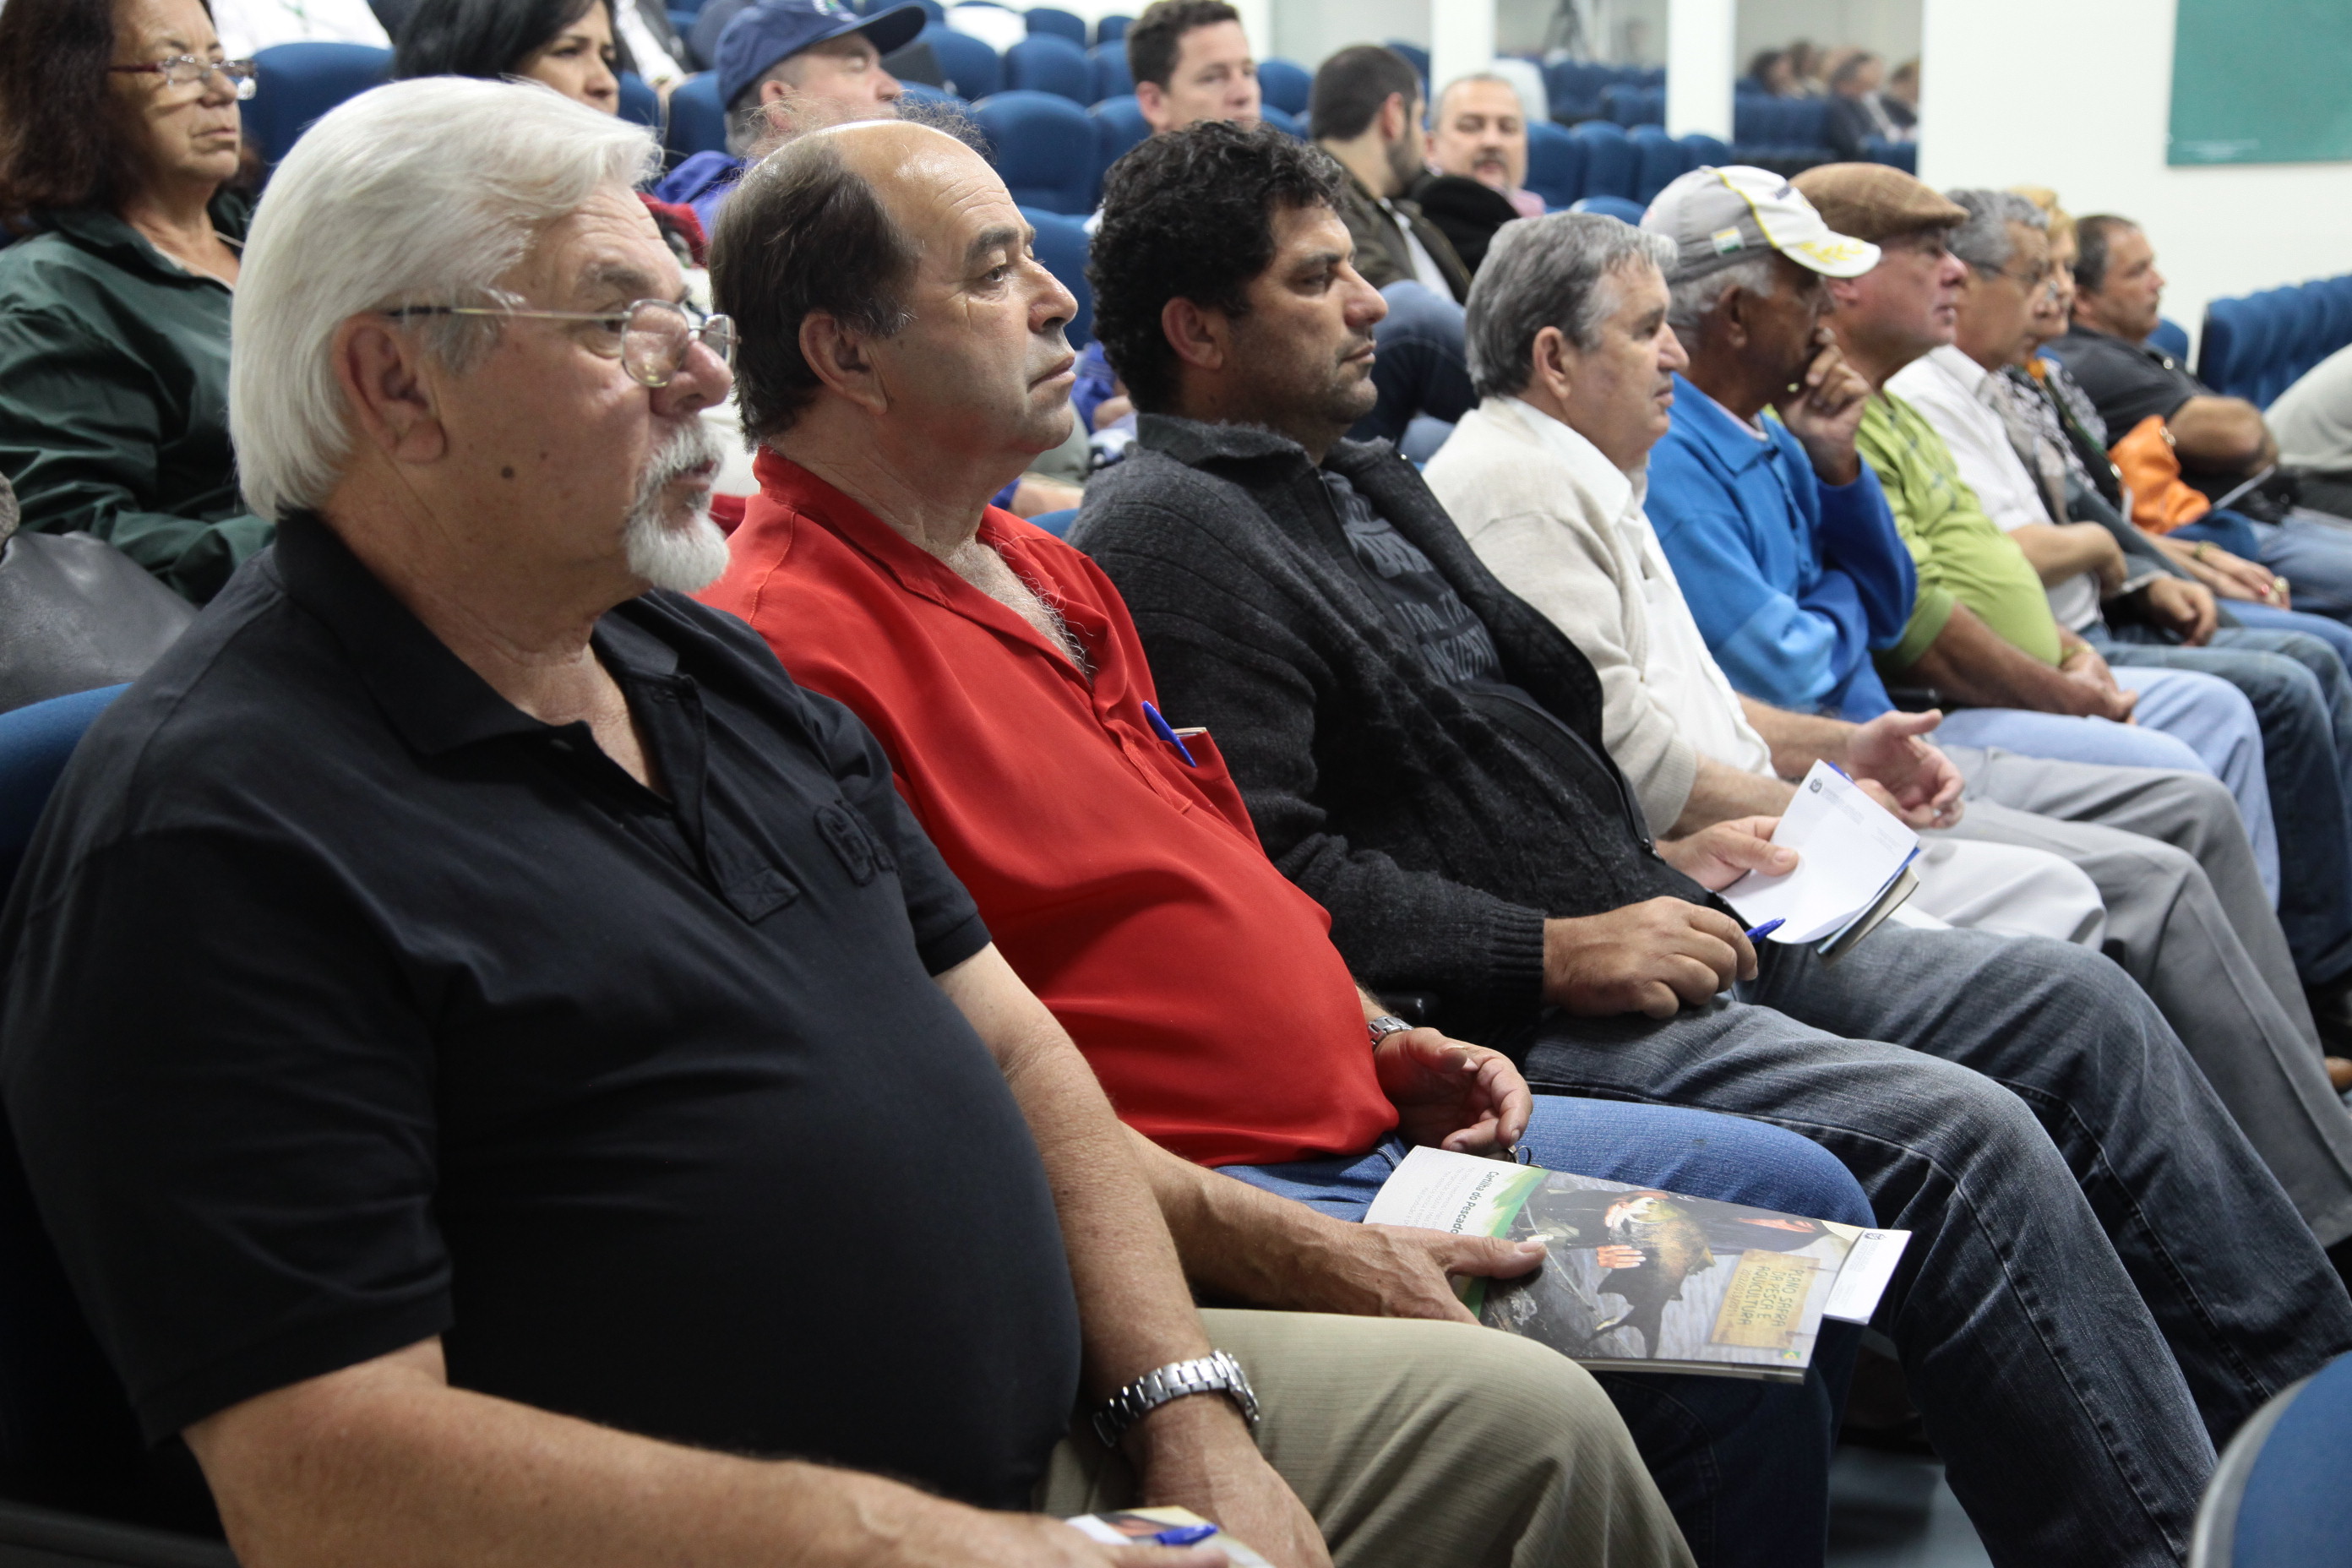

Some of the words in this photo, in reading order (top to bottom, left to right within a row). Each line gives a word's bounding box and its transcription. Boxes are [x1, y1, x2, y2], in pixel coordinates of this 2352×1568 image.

[1475, 1171, 1500, 1191] Cartilha
[1468, 1191, 1482, 1200] do
[1771, 1271, 1784, 1282] DA
[1782, 1268, 1805, 1294] PLANO
[1738, 1266, 1771, 1326] AQUICULTURA
[1760, 1284, 1782, 1310] PESCA
[1771, 1296, 1793, 1327] SAFRA
